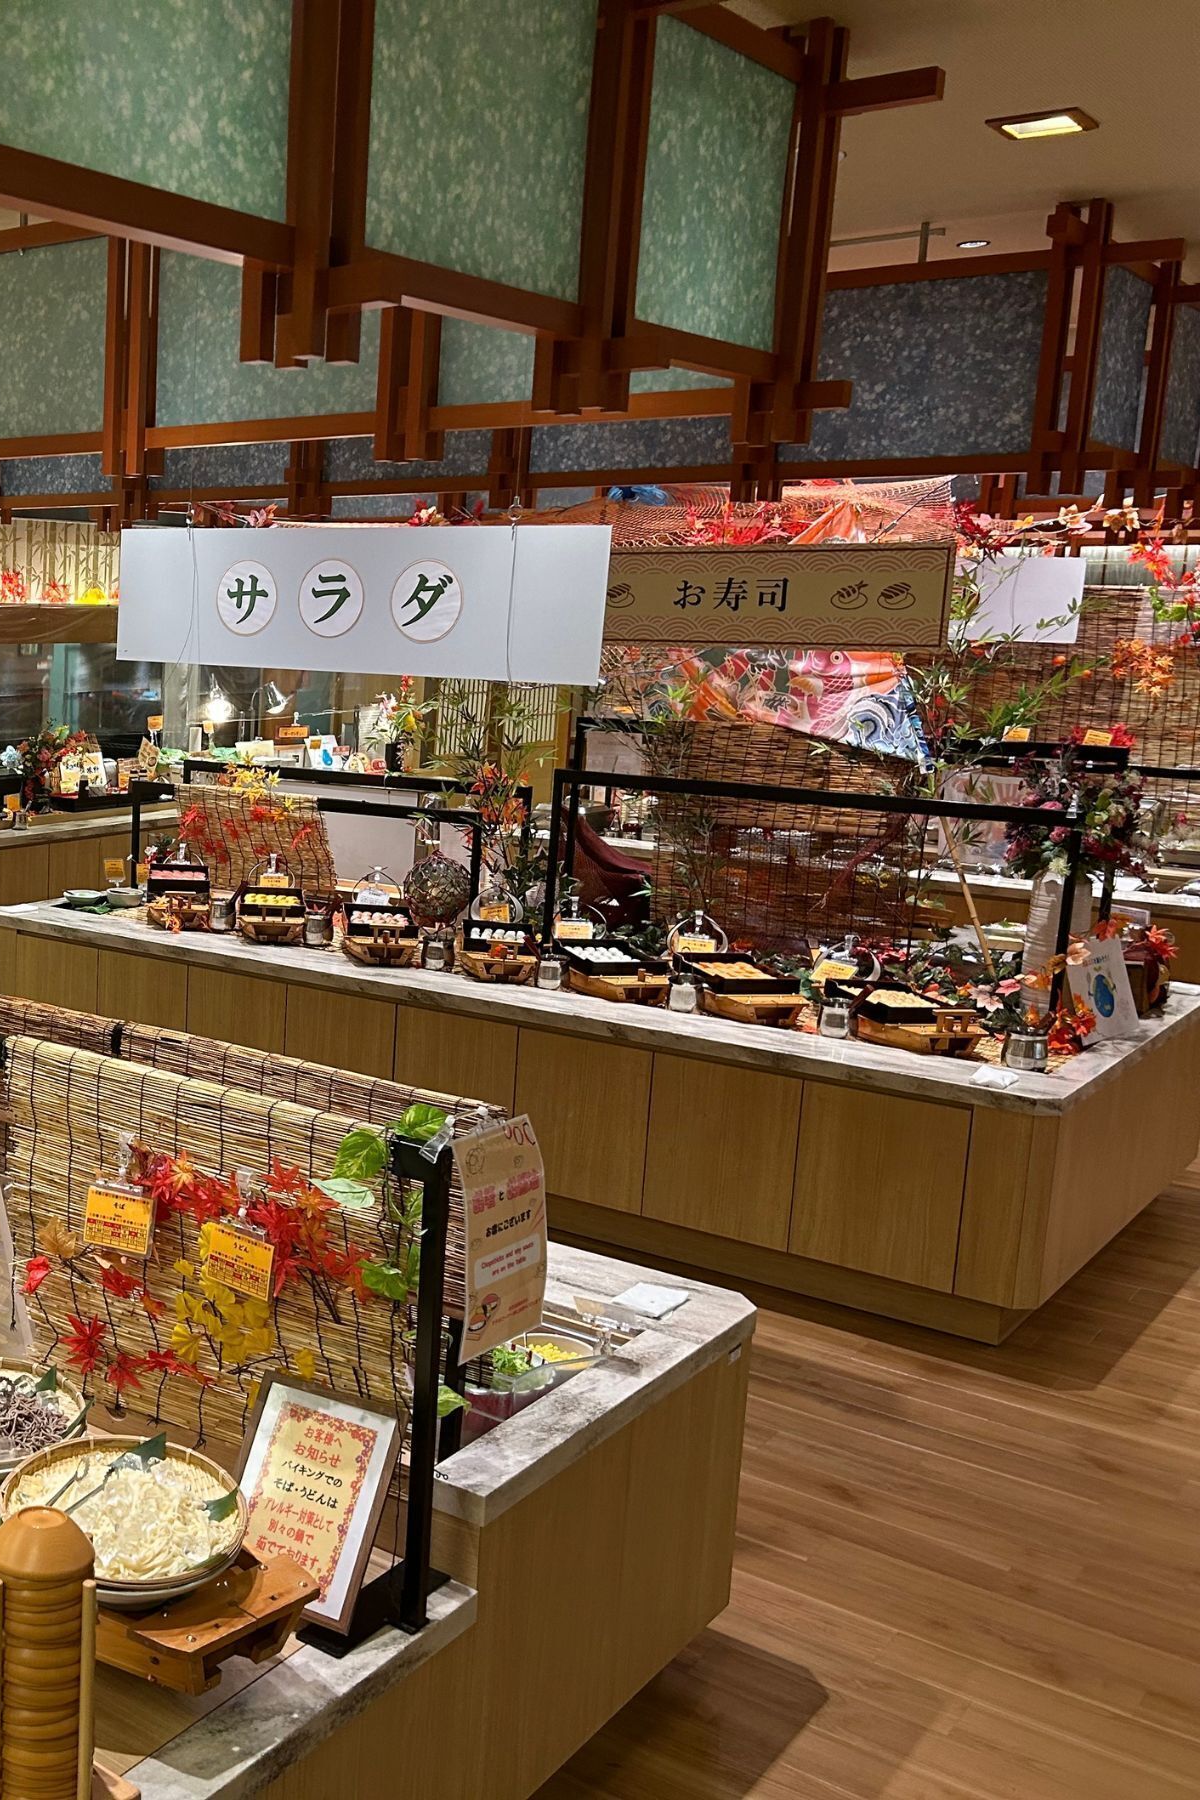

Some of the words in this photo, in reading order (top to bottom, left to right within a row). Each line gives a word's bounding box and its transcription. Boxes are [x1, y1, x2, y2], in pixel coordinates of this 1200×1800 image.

[227, 573, 454, 628] サラダ
[672, 577, 789, 612] お寿司
[113, 1201, 126, 1210] そば
[233, 1241, 250, 1254] うどん
[303, 1425, 343, 1448] お客様へ
[294, 1441, 342, 1468] お知らせ
[281, 1460, 343, 1488] バイキングでの
[273, 1477, 339, 1509] そば・うどんは
[263, 1498, 334, 1533] アレルギー対策として
[267, 1519, 315, 1546] 別々の鍋で
[255, 1534, 322, 1574] 茹でております。
